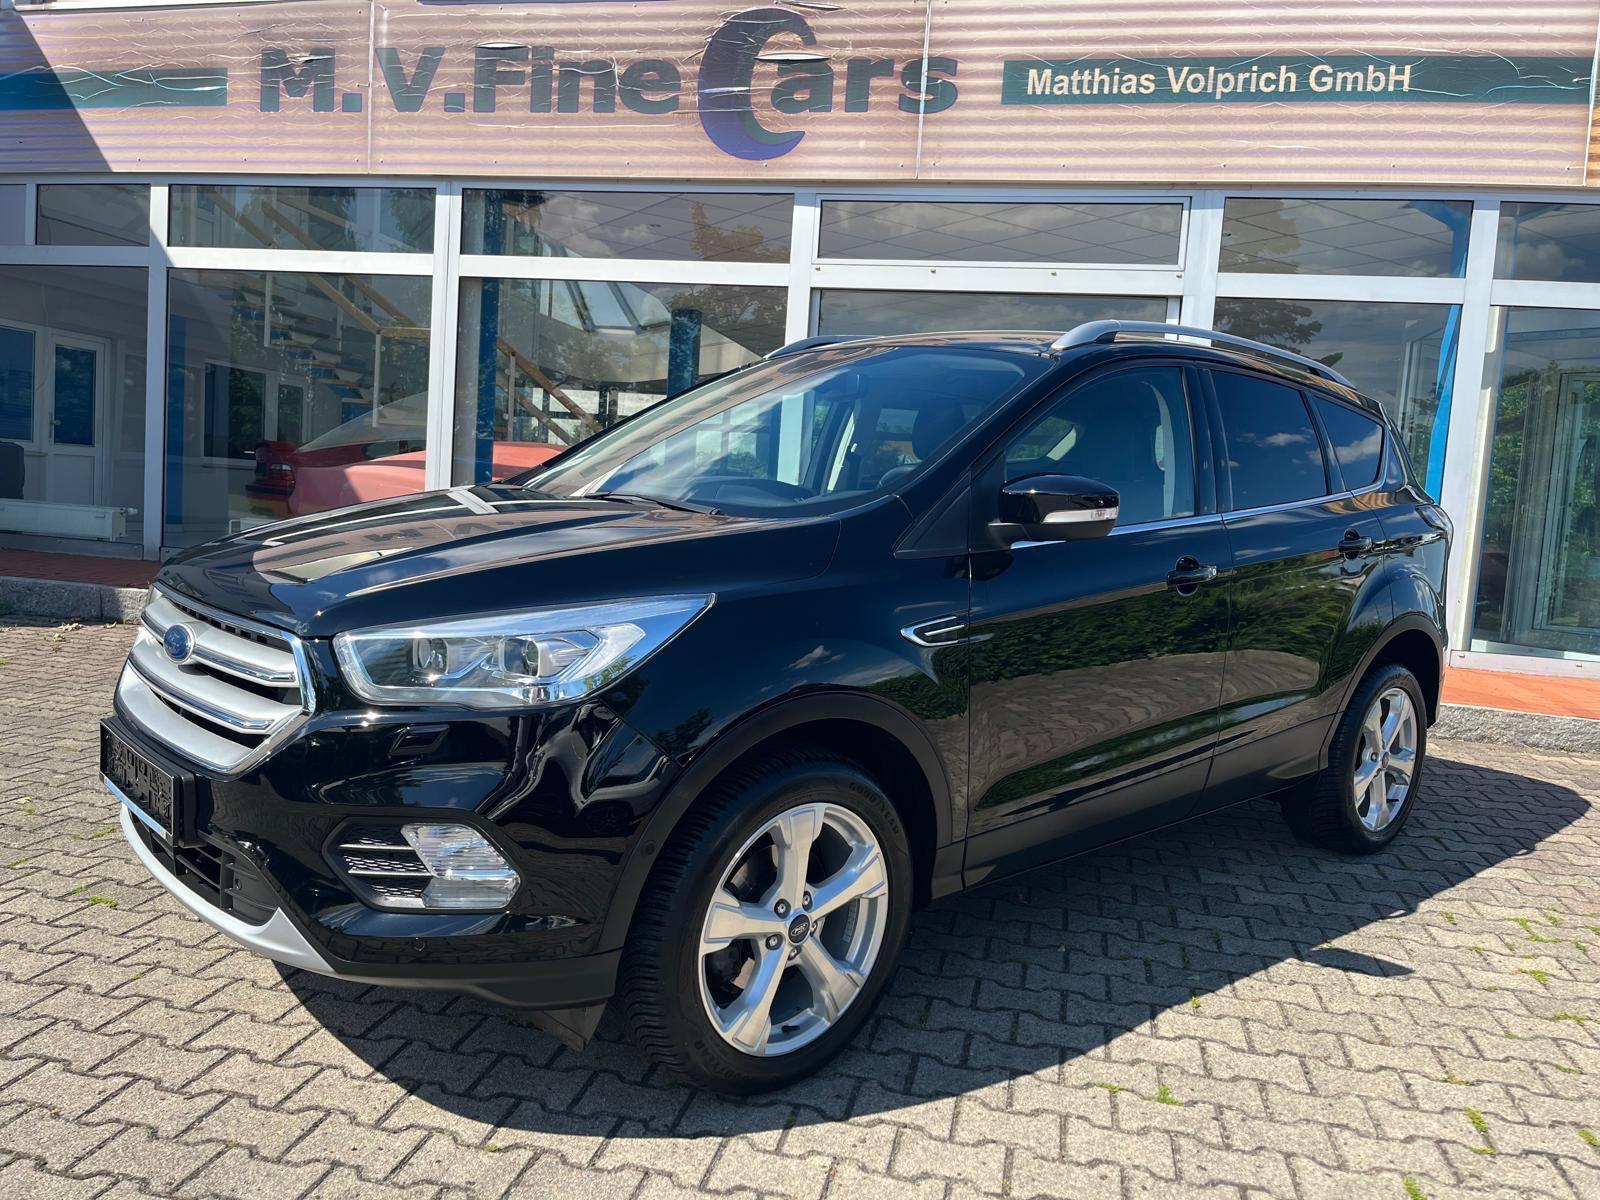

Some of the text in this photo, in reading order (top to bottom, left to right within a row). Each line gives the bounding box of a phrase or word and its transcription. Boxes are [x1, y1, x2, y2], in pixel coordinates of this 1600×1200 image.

[1027, 65, 1411, 99] Matthias Volprich GmbH
